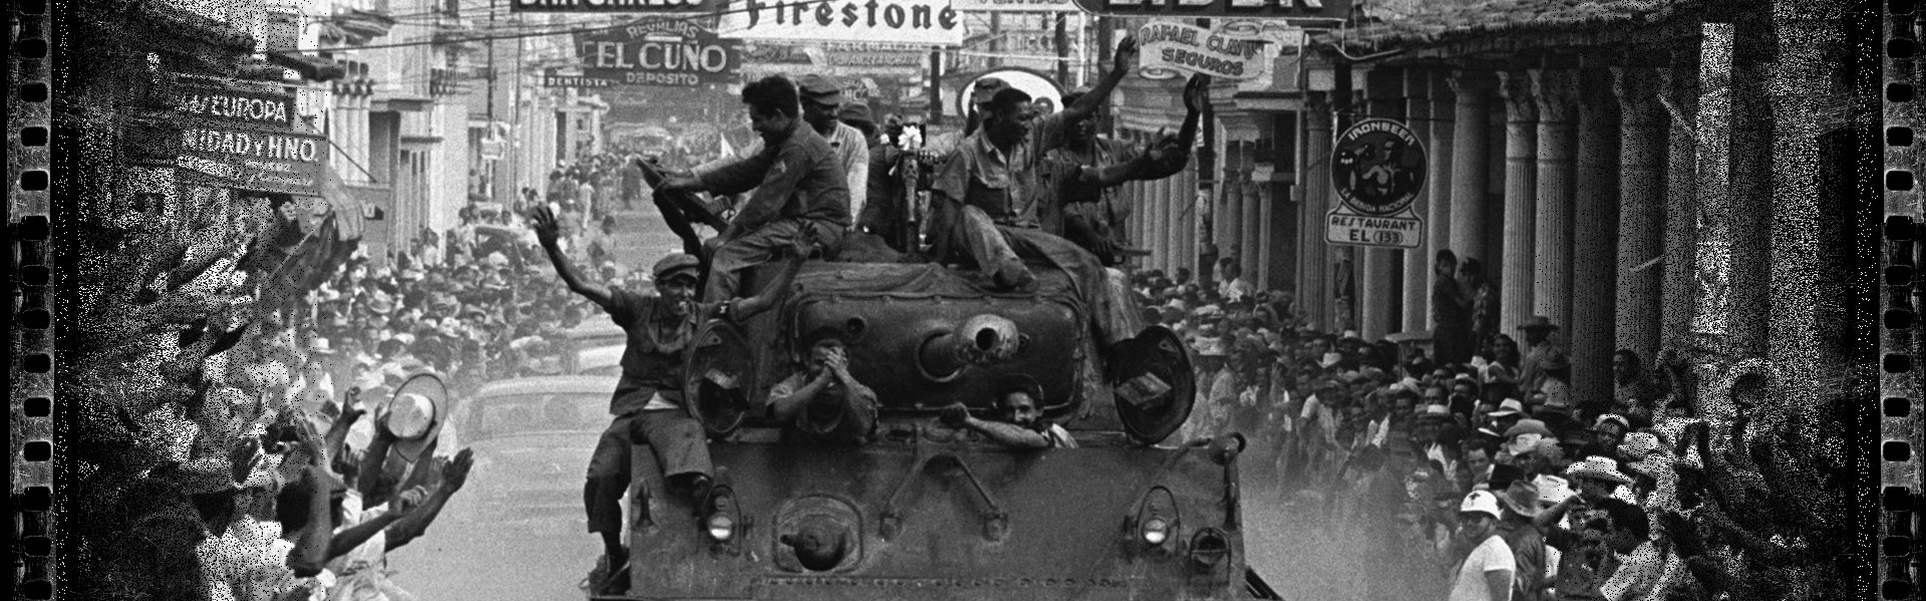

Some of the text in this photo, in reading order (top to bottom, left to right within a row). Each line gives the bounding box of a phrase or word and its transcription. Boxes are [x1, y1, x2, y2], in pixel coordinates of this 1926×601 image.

[747, 0, 957, 29] Firestone
[1140, 24, 1199, 46] RAFAEL
[597, 41, 635, 69] EL
[638, 40, 727, 73] CUÑO
[1162, 46, 1244, 76] SEGUROS
[549, 76, 608, 87] DENTISTA
[626, 72, 699, 85] DEPOSITO
[210, 95, 287, 122] EUROPA
[182, 128, 251, 155] NIDAD
[1348, 121, 1415, 146] IRONBEER
[1331, 216, 1416, 231] RESTAURANT
[1350, 229, 1400, 243] EL 133
